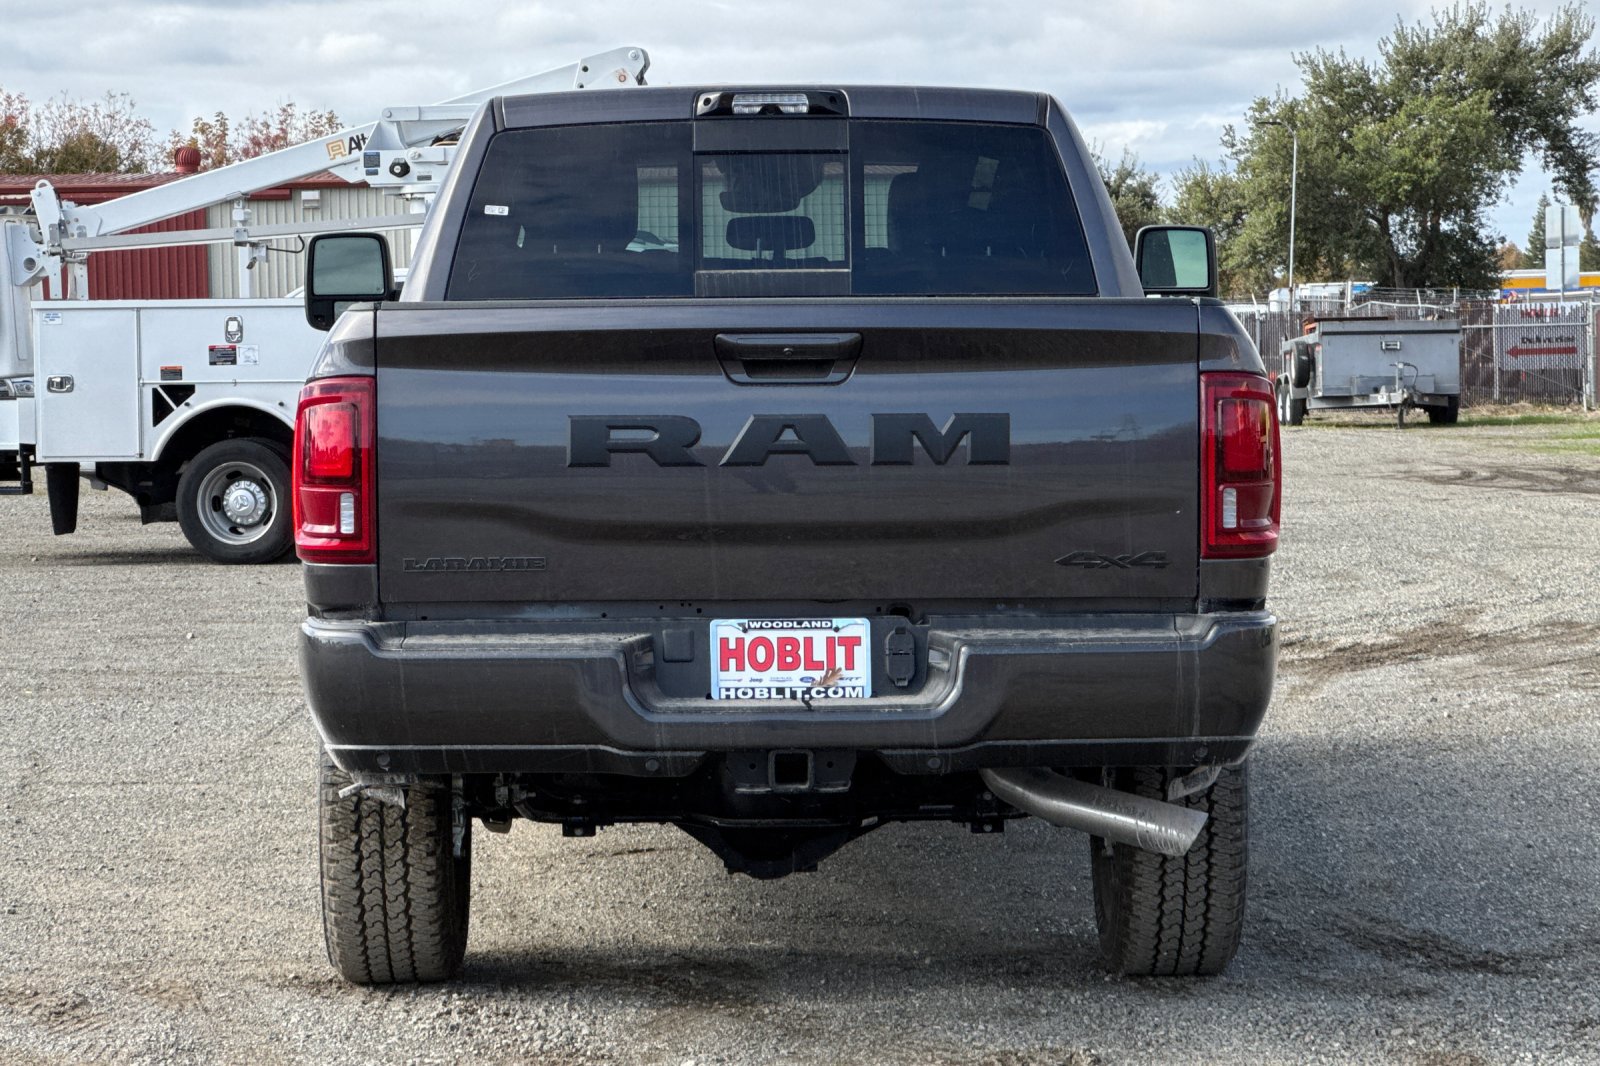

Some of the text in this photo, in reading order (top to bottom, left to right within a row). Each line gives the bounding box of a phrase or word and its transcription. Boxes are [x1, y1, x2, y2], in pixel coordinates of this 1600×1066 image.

[348, 133, 368, 155] Alt
[566, 413, 1010, 468] RAM
[403, 556, 546, 572] LARAMIE
[749, 620, 833, 630] WOODLAND
[719, 635, 862, 673] HOBLIT
[720, 686, 864, 700] HOBLIT.COM
